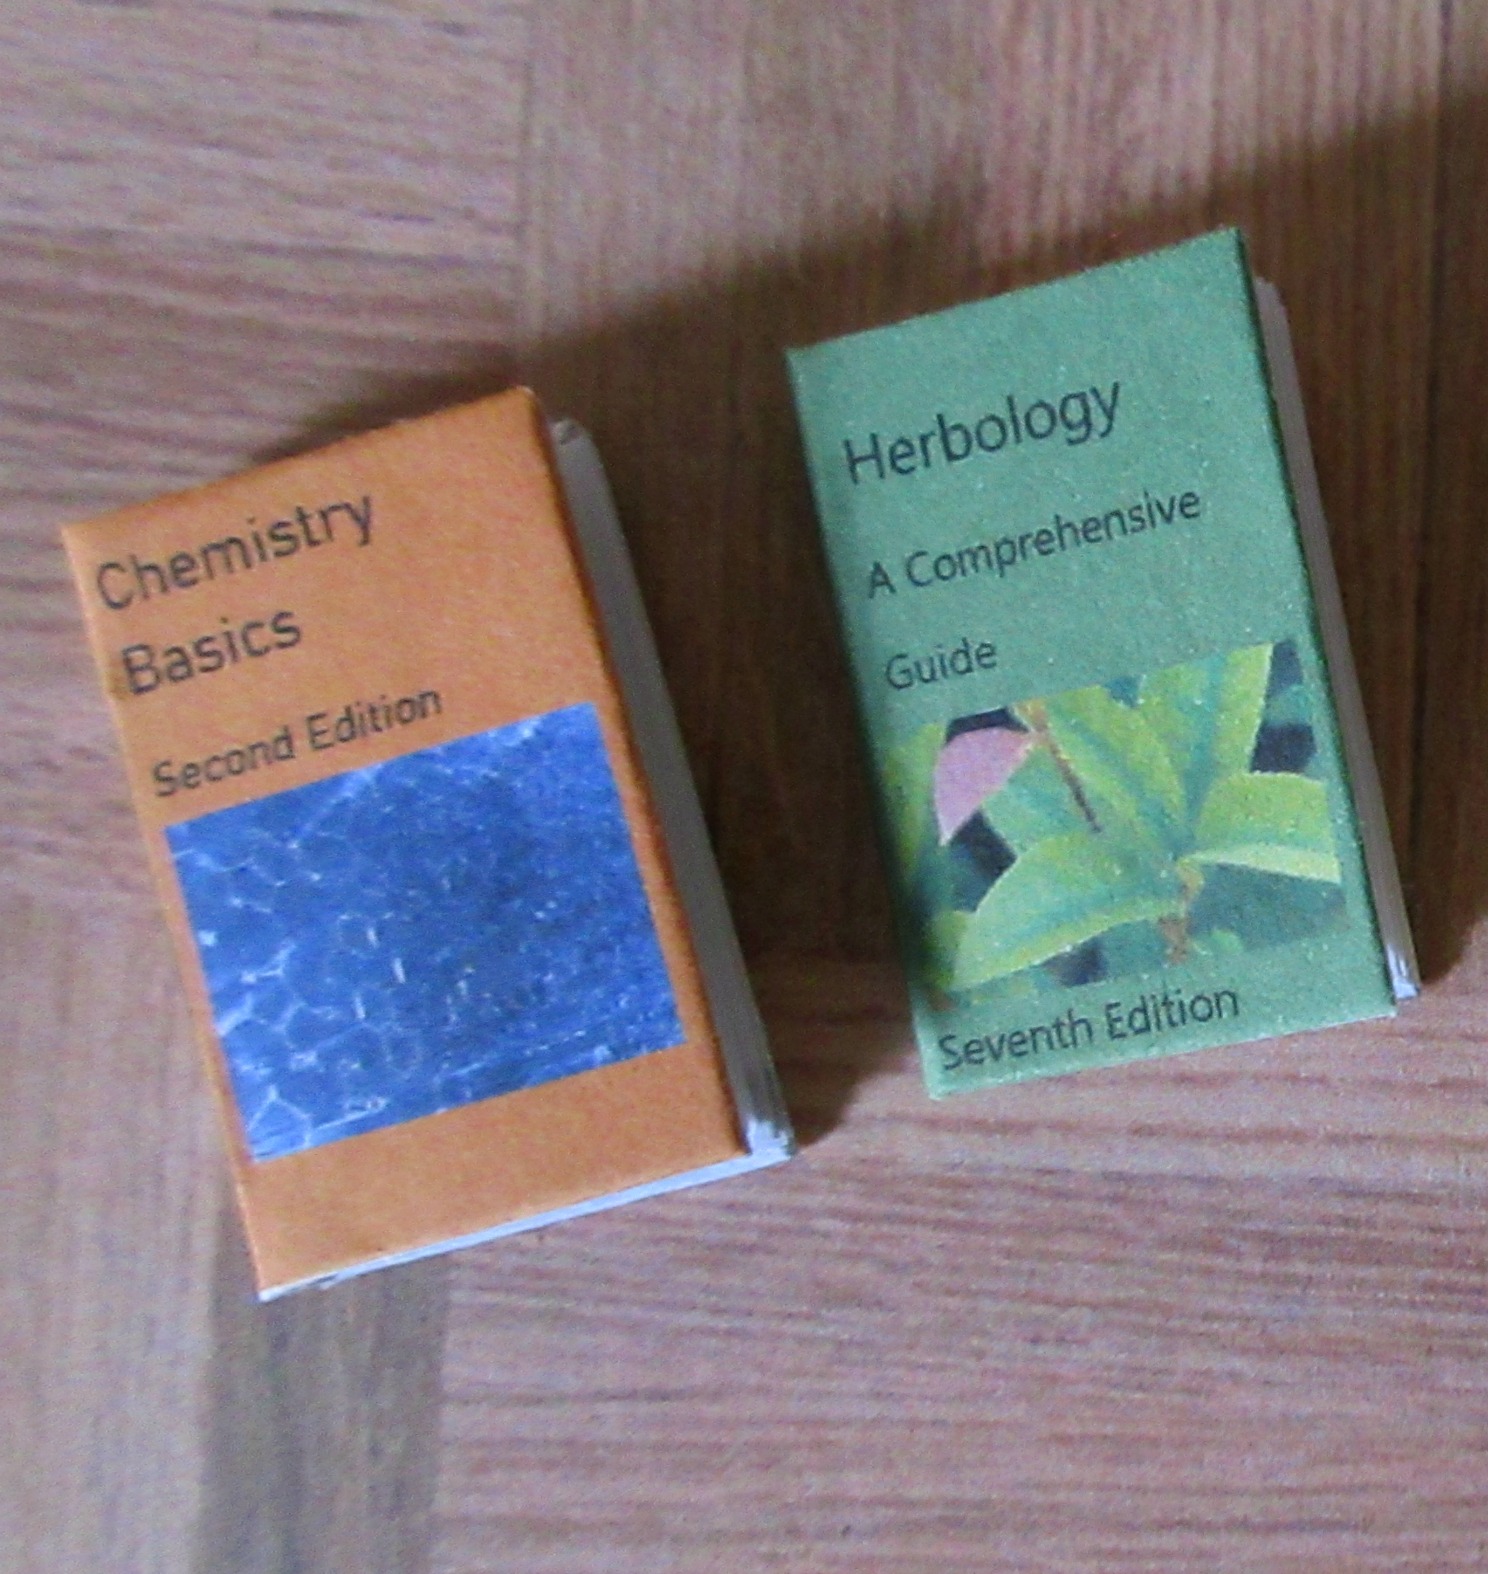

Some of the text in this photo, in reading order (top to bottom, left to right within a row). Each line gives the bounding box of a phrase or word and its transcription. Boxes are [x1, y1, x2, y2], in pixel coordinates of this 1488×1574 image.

[844, 382, 1121, 484] Herbology
[96, 495, 372, 610] Chemistry
[866, 490, 1201, 599] A Comprehensive
[120, 607, 302, 696] Basics
[885, 637, 998, 693] Guide
[153, 688, 442, 797] Second Edition
[938, 988, 1239, 1071] Seventh Edition
